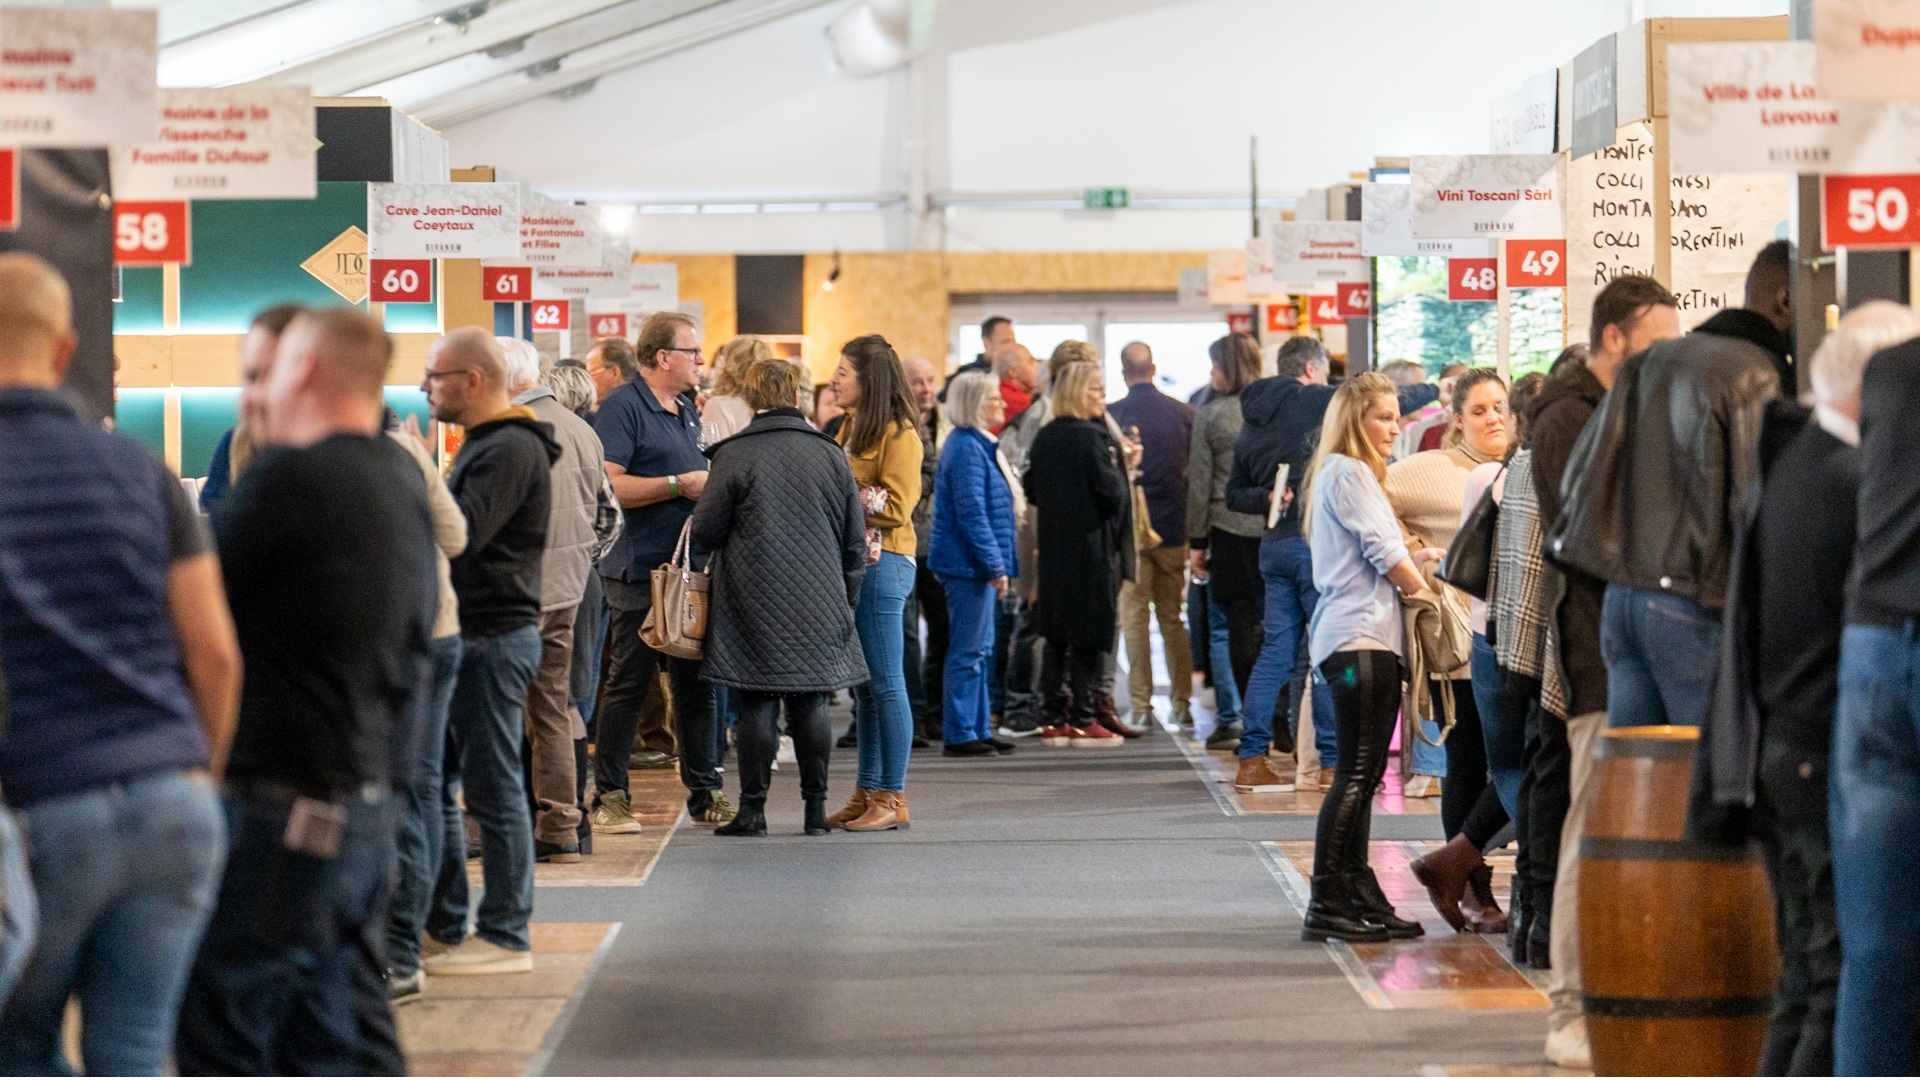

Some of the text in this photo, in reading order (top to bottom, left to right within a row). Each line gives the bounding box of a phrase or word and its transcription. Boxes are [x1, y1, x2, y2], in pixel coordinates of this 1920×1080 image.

[1703, 83, 1750, 100] Ville
[1755, 83, 1783, 100] de
[1761, 109, 1839, 125] Lavaux
[132, 149, 200, 164] Famille
[1596, 172, 1711, 190] COLLI NESI
[1437, 189, 1463, 201] Vini
[1469, 189, 1520, 201] Toscani
[386, 204, 503, 216] Cave Jean-Daniel
[1846, 187, 1910, 233] 50
[413, 219, 475, 232] Coeytaux
[521, 216, 576, 226] Madeleine
[115, 211, 169, 251] 58
[531, 228, 585, 238] Fontannaz
[1593, 226, 1744, 251] COLLI ORENTINI
[522, 240, 561, 249] et Filles
[1521, 250, 1560, 276] 49
[381, 268, 419, 293] 60
[496, 274, 519, 294] 61
[1461, 267, 1497, 291] 48
[534, 305, 560, 325] 62
[596, 318, 620, 335] 63
